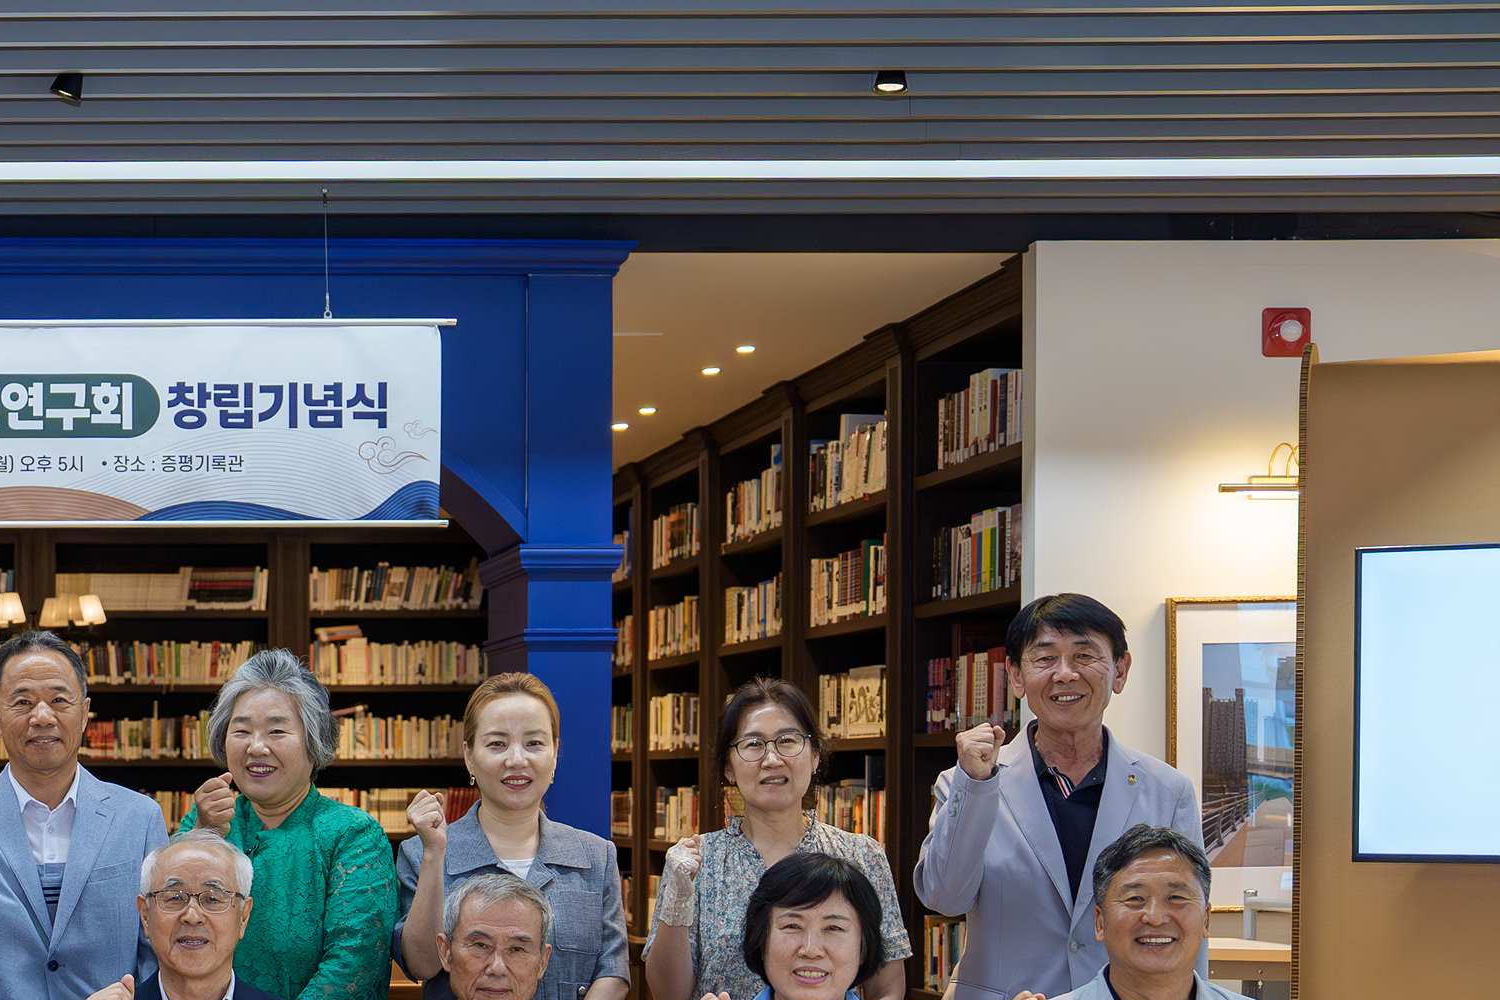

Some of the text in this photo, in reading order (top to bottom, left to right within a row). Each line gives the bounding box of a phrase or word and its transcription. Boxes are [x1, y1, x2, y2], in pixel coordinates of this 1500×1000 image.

[167, 381, 388, 430] 창립기념식
[20, 455, 52, 473] 오후
[58, 455, 84, 473] 5시
[113, 455, 146, 473] 장소
[161, 455, 245, 473] 증평기록관
